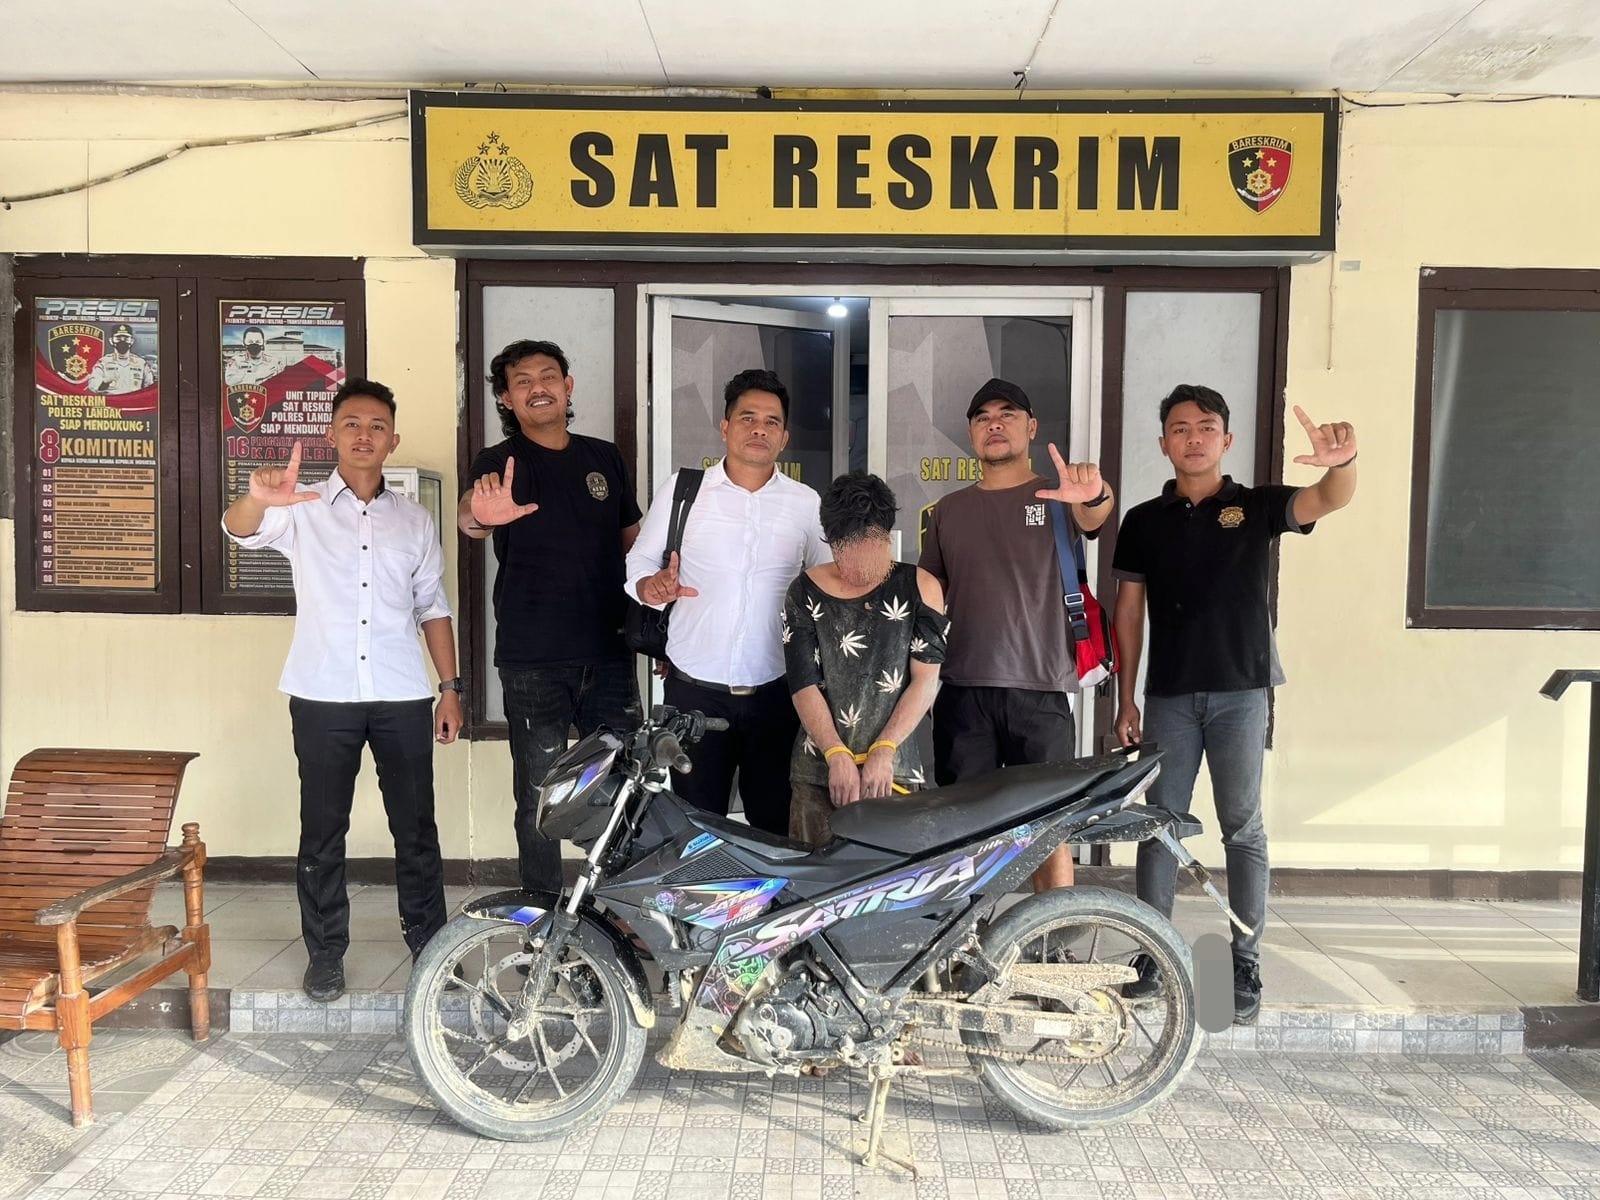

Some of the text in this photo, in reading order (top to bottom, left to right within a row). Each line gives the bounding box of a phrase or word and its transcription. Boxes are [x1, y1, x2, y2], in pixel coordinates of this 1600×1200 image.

[1231, 136, 1289, 150] BARESKRIM
[569, 131, 1181, 212] SAT RESKRIM
[45, 300, 148, 316] PRESISI
[229, 305, 334, 319] PRESISI
[53, 326, 101, 337] BARESKRIM
[41, 395, 106, 407] SAT RESKRIM
[286, 391, 304, 401] UNIT
[48, 407, 122, 419] POLRES LANDAK
[283, 402, 333, 413] SAT RESKRI
[272, 412, 304, 423] POLRES
[60, 420, 82, 430] SIAP
[84, 420, 144, 432] MENDUKUNG
[261, 424, 281, 434] SIAP
[40, 428, 60, 464] 8
[61, 437, 154, 458] KOMITMEN
[227, 436, 250, 458] 16
[251, 447, 333, 460] KAPLRI
[42, 468, 53, 477] 01
[921, 458, 951, 480] SAT
[42, 484, 53, 493] 02
[42, 499, 53, 508] 03
[42, 514, 53, 523] 04
[42, 530, 53, 539] 05
[42, 560, 53, 569] 07
[738, 856, 977, 958] SATRIA
